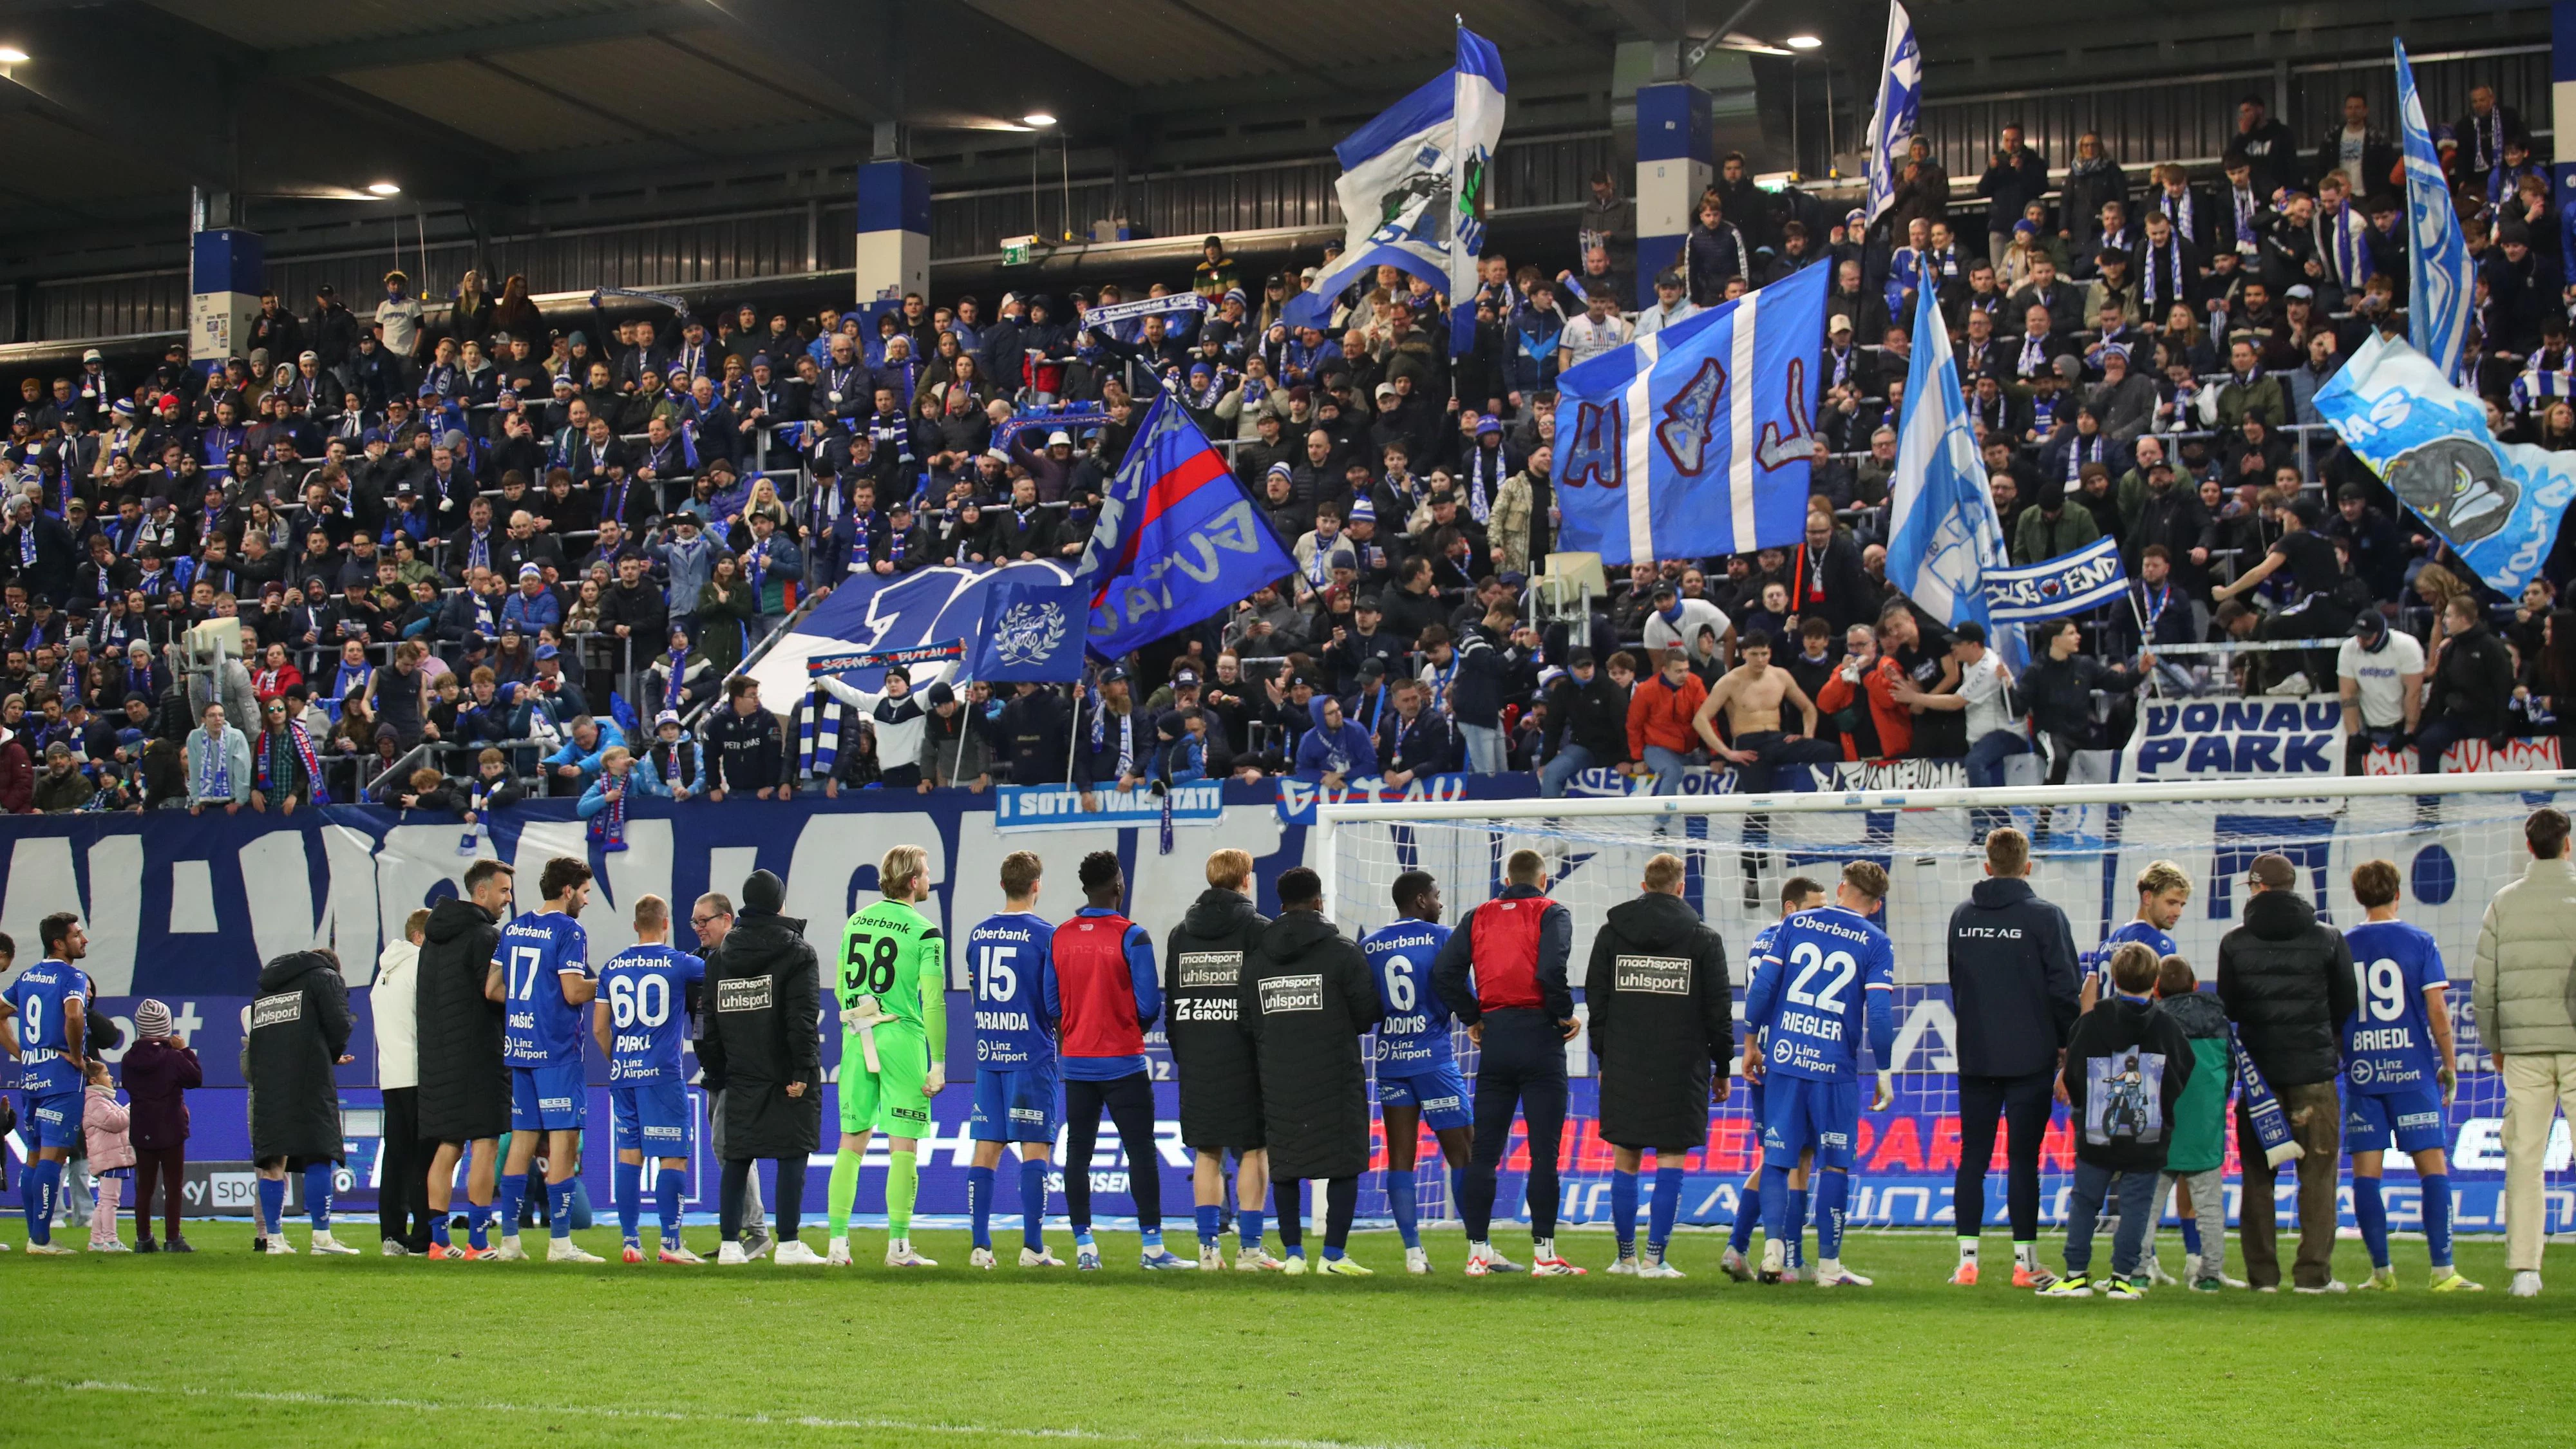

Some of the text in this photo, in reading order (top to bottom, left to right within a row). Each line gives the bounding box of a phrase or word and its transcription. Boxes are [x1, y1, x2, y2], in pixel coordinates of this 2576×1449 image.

[2146, 702, 2341, 737] DONAU
[2137, 734, 2335, 773] PARK
[1280, 775, 1463, 817] GUTAU
[1000, 794, 1010, 818] I
[505, 923, 553, 940] Oberbank
[853, 914, 911, 934] Oberbank
[1792, 916, 1871, 946] Oberbank
[972, 927, 1031, 942] Oberbank
[1958, 927, 2022, 939] LINZ AG
[1365, 933, 1435, 954] Oberbank
[609, 954, 672, 971] Oberbank
[845, 933, 898, 994] 58
[1180, 952, 1242, 965] machsport
[1618, 957, 1689, 971] machsport
[21, 971, 59, 985] Oberbank
[508, 945, 542, 1001] 17
[979, 945, 1017, 1002] 15
[1182, 969, 1238, 984] uhlsport
[1620, 972, 1685, 990] uhlsport
[1786, 942, 1857, 1015] 22
[720, 976, 771, 990] machsport
[1260, 976, 1321, 991] machsport
[1385, 954, 1416, 1012] 6
[2353, 958, 2405, 1023] 19
[256, 992, 301, 1010] machsport
[609, 973, 670, 1028] 60
[721, 992, 769, 1009] uhlsport
[1264, 992, 1319, 1010] uhlsport
[24, 993, 43, 1045] 9
[255, 1005, 298, 1024] uhlsport
[509, 1012, 535, 1029] PAŠIĆ
[1779, 1010, 1842, 1042] RIEGLER
[513, 1037, 533, 1048] Linz
[990, 1040, 1012, 1051] Linz
[1390, 1041, 1414, 1049] Linz
[2353, 1027, 2414, 1052] BRIEDL
[512, 1049, 547, 1060] Airport
[990, 1051, 1028, 1063] Airport
[1390, 1048, 1432, 1061] Airport
[1794, 1043, 1821, 1058] Linz
[623, 1059, 643, 1068] Linz
[1792, 1056, 1836, 1074] Airport
[2375, 1059, 2403, 1070] Linz
[623, 1066, 660, 1079] Airport
[2237, 1050, 2266, 1097] KIDS
[2376, 1069, 2421, 1084] Airport
[538, 1097, 572, 1108] LEEB
[891, 1106, 927, 1121] LEEB
[1008, 1107, 1044, 1121] LEEB
[643, 1126, 682, 1137] LEEB
[1786, 1239, 1795, 1270] WEST
